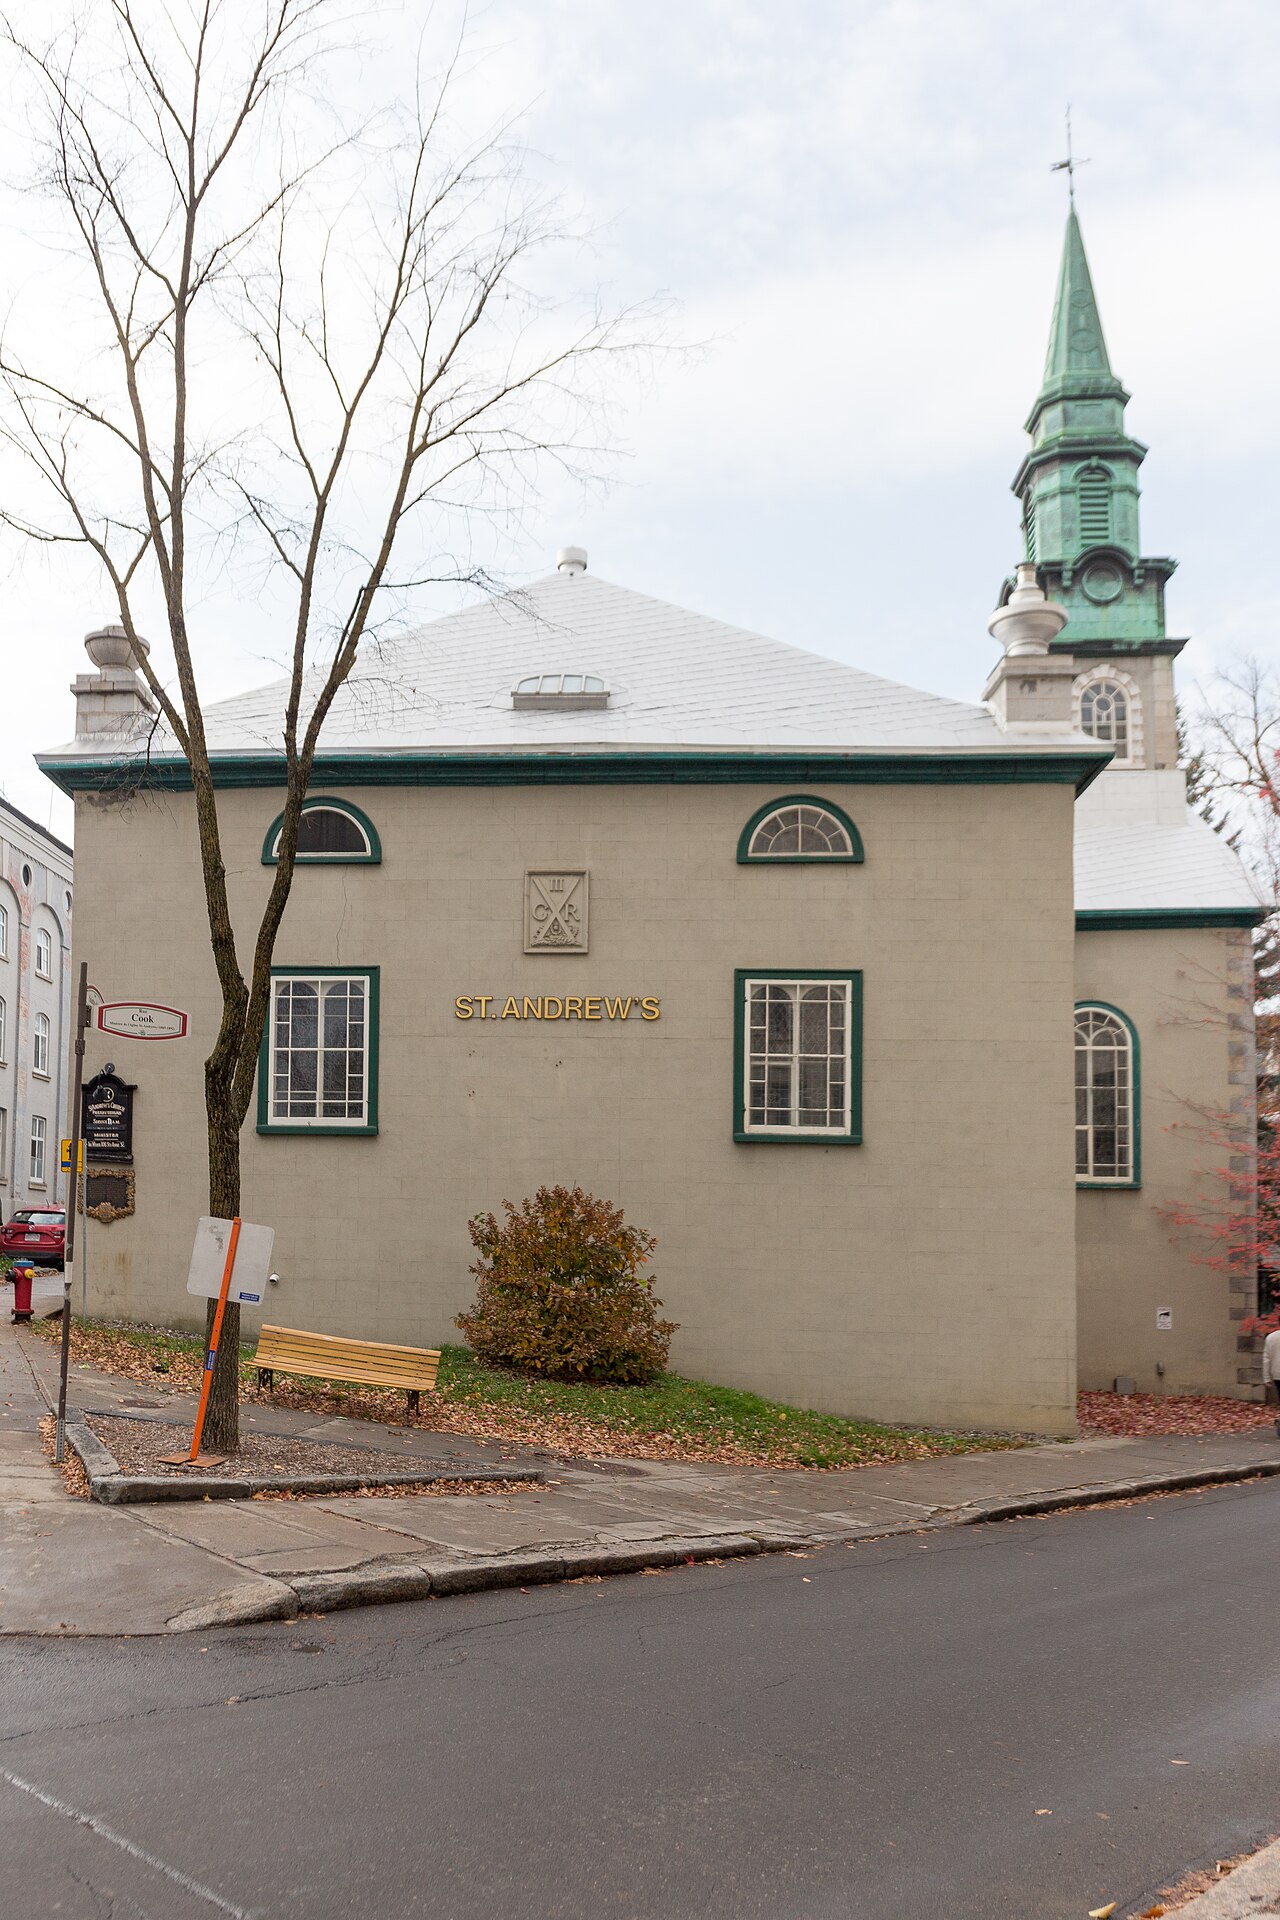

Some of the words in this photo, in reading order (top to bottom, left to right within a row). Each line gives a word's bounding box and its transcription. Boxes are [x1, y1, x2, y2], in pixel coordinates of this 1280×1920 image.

[564, 904, 580, 922] R
[455, 996, 497, 1020] ST.
[501, 996, 661, 1020] ANDREW'S
[131, 1014, 154, 1023] Cook
